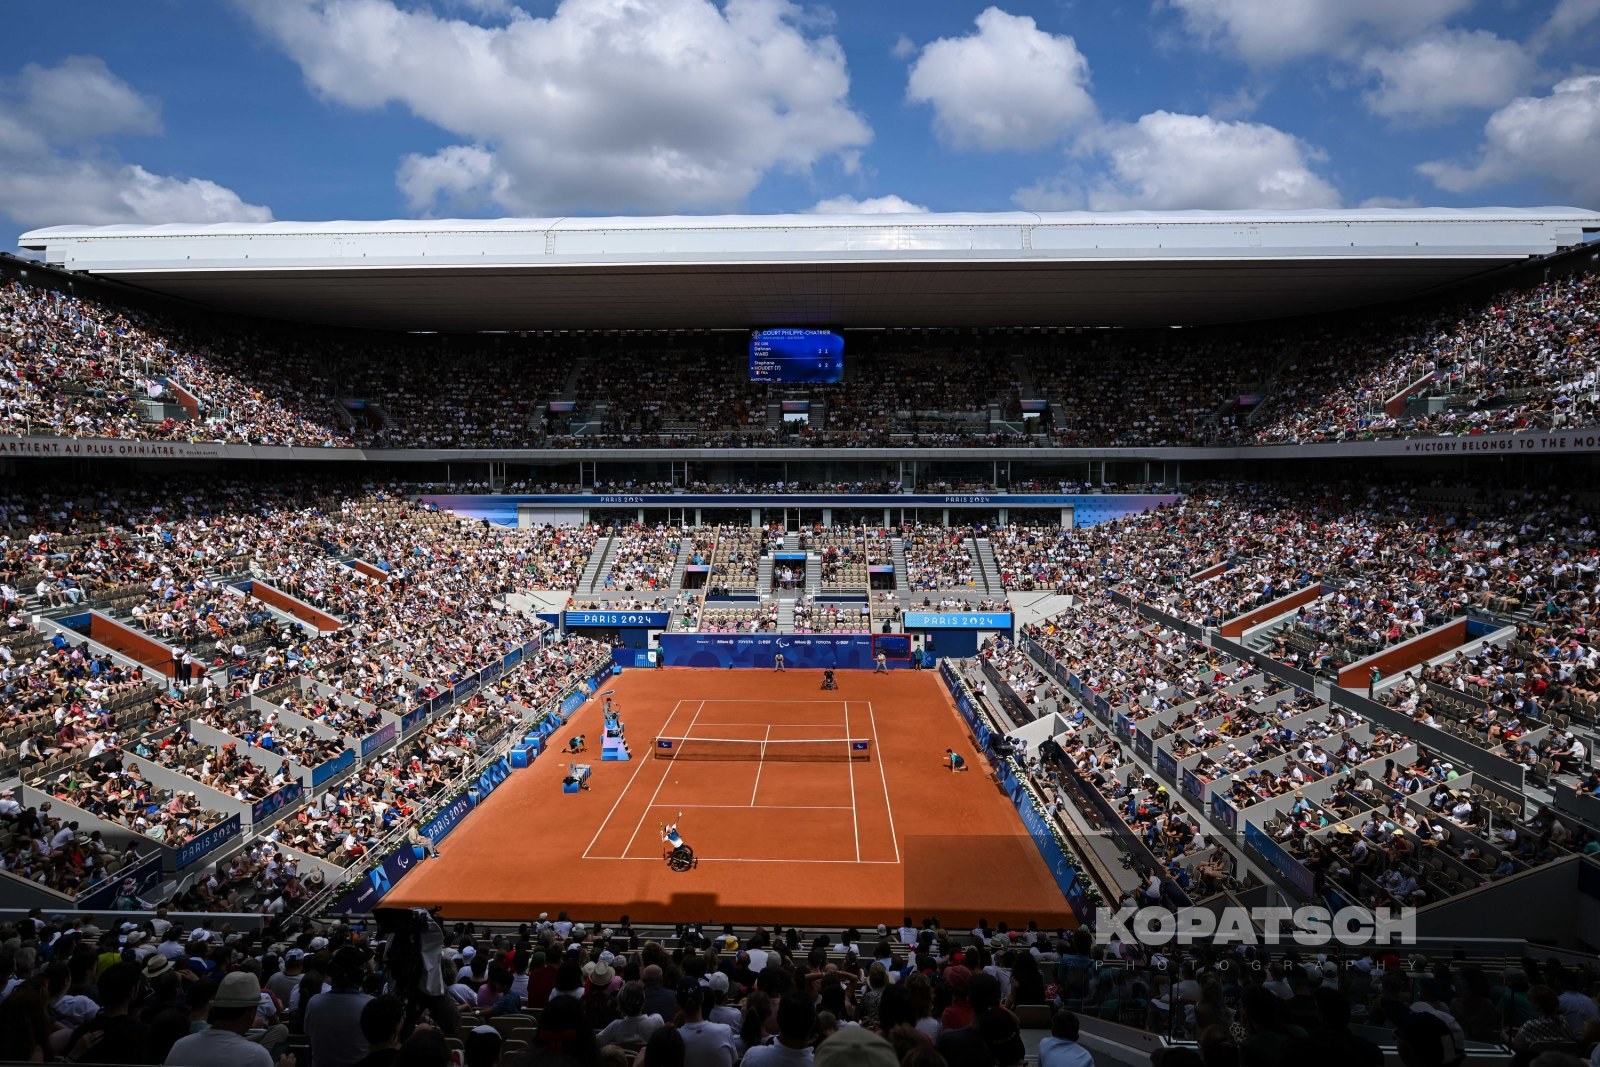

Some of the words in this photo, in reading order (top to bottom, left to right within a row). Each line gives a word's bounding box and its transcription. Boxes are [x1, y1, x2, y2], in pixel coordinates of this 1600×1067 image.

[65, 444, 80, 452] AU
[87, 444, 114, 454] PLUS
[119, 444, 174, 455] OPINIÂTRE
[1414, 442, 1457, 452] VICTORY
[1462, 440, 1513, 451] BELONGS
[1519, 438, 1535, 448] TO
[1541, 438, 1566, 448] THE
[584, 615, 617, 623] PARIS
[621, 616, 651, 624] 2024
[428, 814, 450, 840] PARIS
[449, 800, 468, 821] 2024
[1024, 806, 1037, 829] PARIS
[182, 837, 210, 861] PARIS
[213, 822, 236, 842] 2024
